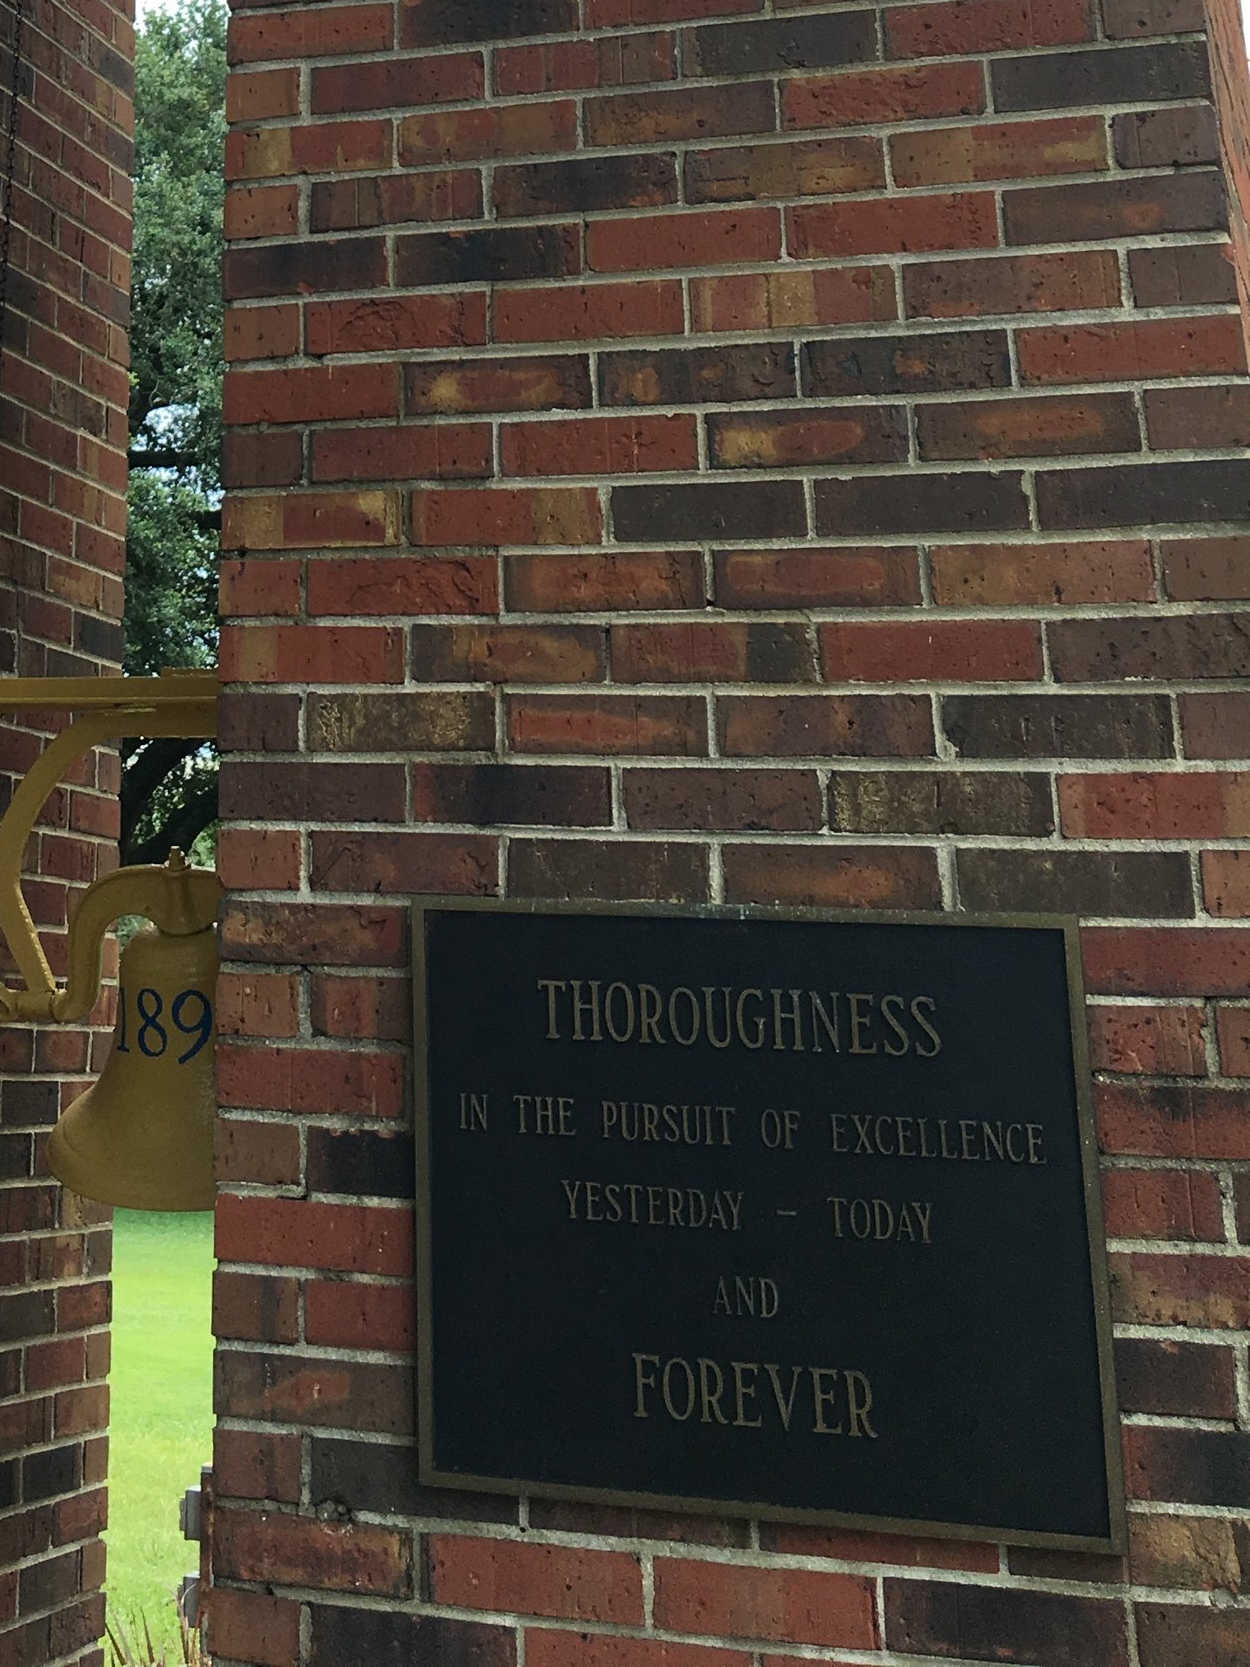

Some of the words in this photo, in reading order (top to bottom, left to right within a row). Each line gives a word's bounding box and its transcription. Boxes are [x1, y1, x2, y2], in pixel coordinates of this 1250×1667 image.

[536, 978, 944, 1057] THOROUGHNESS
[459, 1092, 488, 1132] IN
[513, 1095, 576, 1137] THE
[602, 1100, 736, 1148] PURSUIT
[760, 1108, 801, 1150] OF
[830, 1113, 1048, 1165] EXCELLENCE
[560, 1179, 745, 1232] YESTERDAY
[826, 1196, 934, 1245] TODAY
[712, 1276, 780, 1320] AND
[631, 1352, 879, 1440] FOREVER
